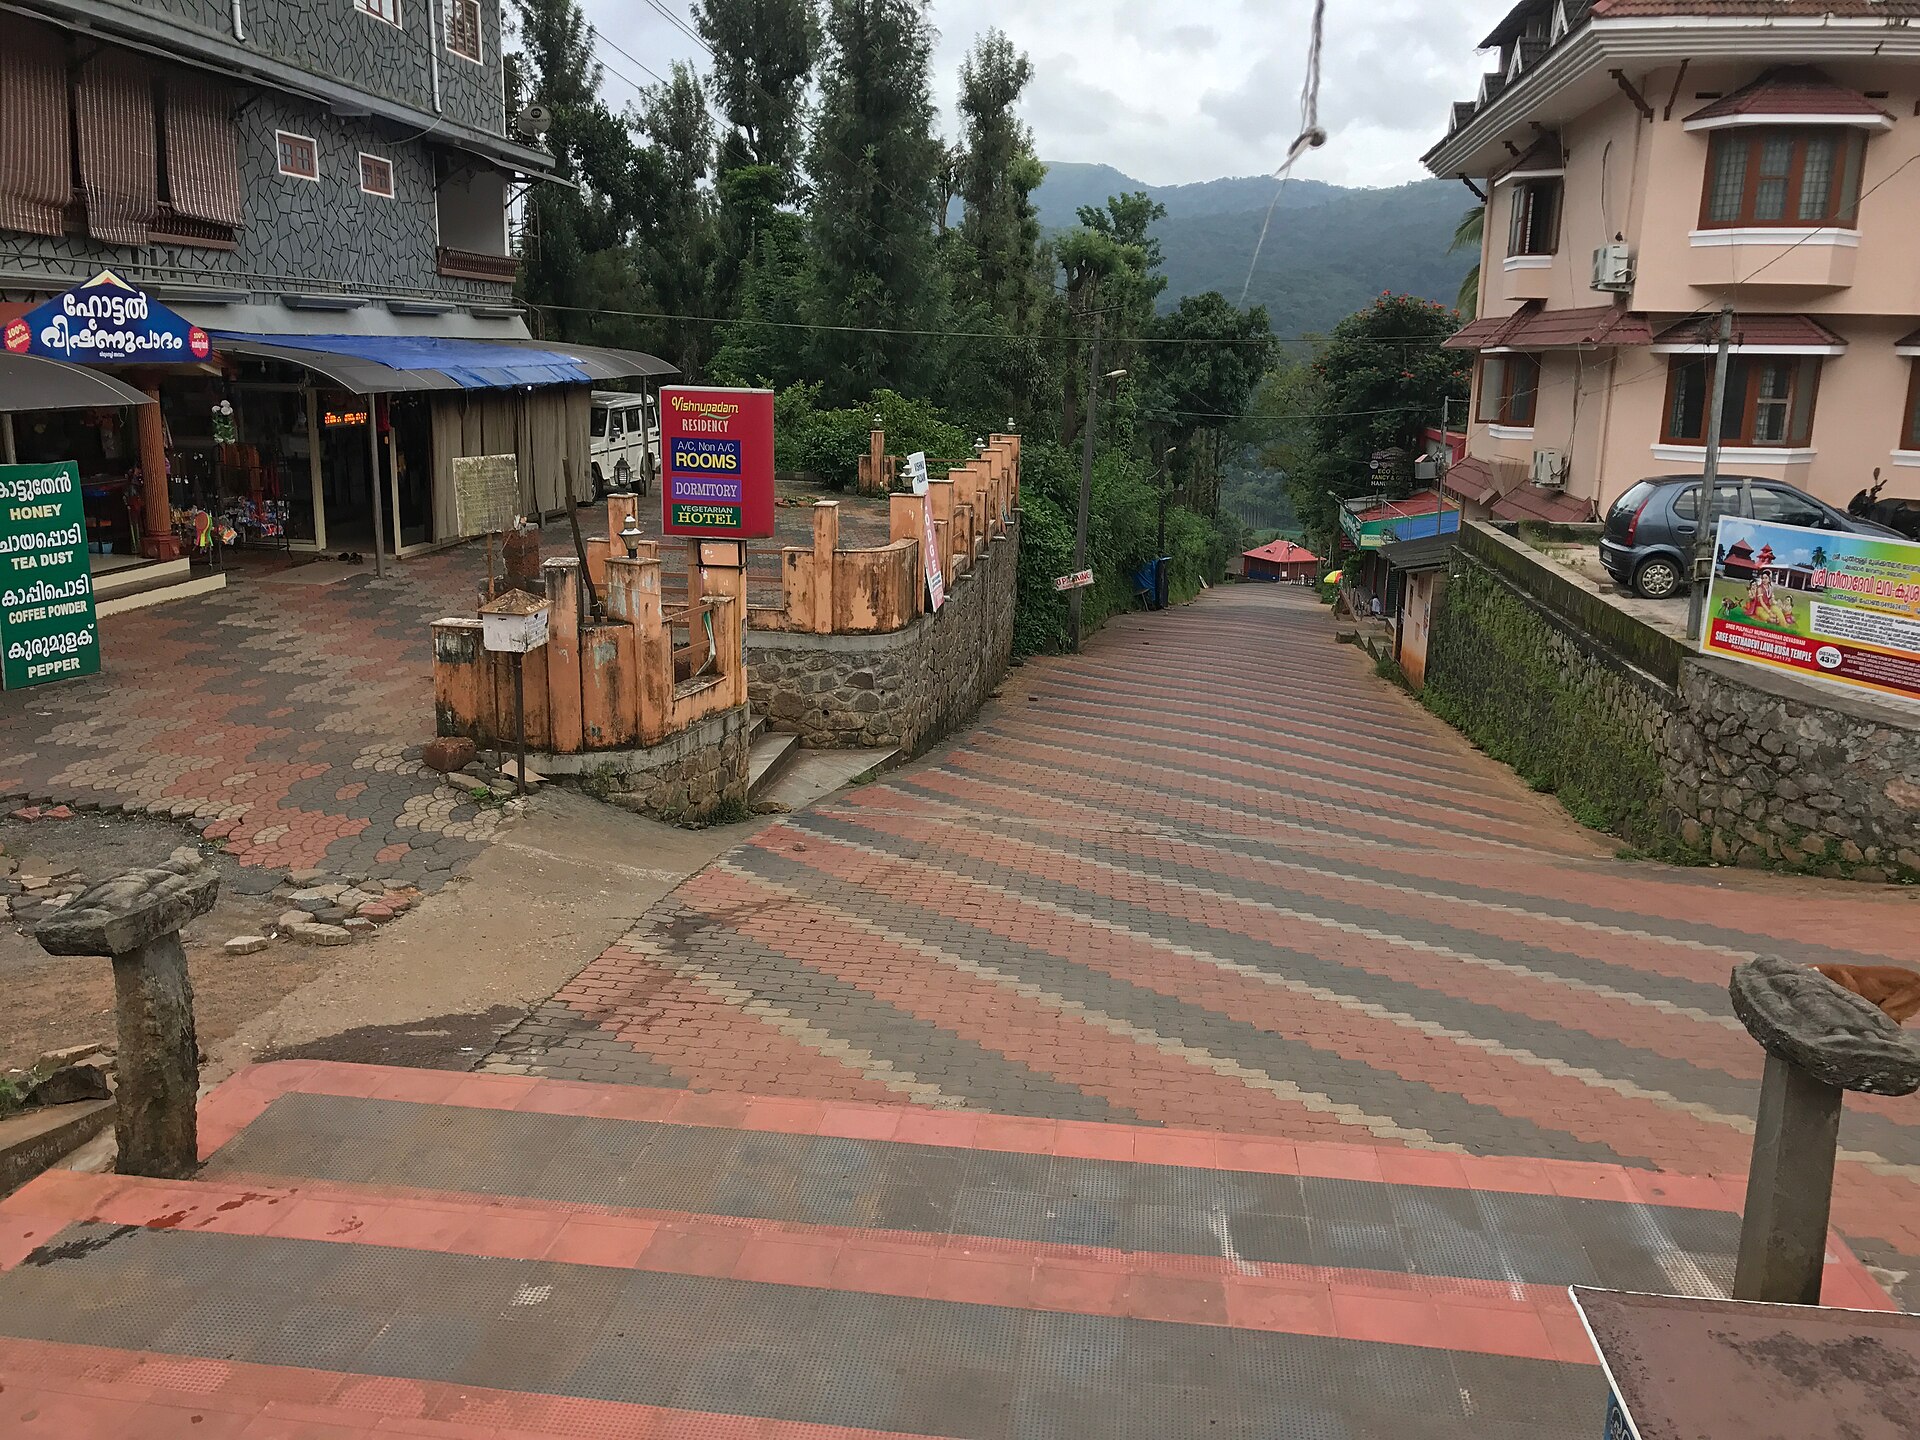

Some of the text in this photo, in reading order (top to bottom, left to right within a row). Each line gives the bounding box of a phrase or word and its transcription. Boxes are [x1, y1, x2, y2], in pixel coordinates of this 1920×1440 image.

[63, 291, 149, 326] ഹോട്ടൽ
[40, 315, 183, 357] വിഷ്ണുപാദം
[671, 396, 739, 415] Vishnupadam
[682, 418, 729, 433] RESIDENCY
[677, 440, 735, 453] A/C, Non A/C
[675, 452, 737, 469] ROOMS
[675, 482, 738, 497] DORMITORY
[10, 504, 62, 521] HONEY
[680, 505, 733, 514] VEGETARIAN
[677, 512, 737, 525] HOTEL
[11, 551, 73, 570] TEA DUST
[8, 600, 88, 625] COFFEE POWDER
[8, 623, 95, 662] കുരുമുളക്
[1715, 630, 1729, 642] SREE
[1790, 648, 1812, 662] TEMPLE
[1818, 650, 1840, 660] DISTANCE
[1819, 655, 1830, 664] 43
[28, 657, 81, 679] PEPPER
